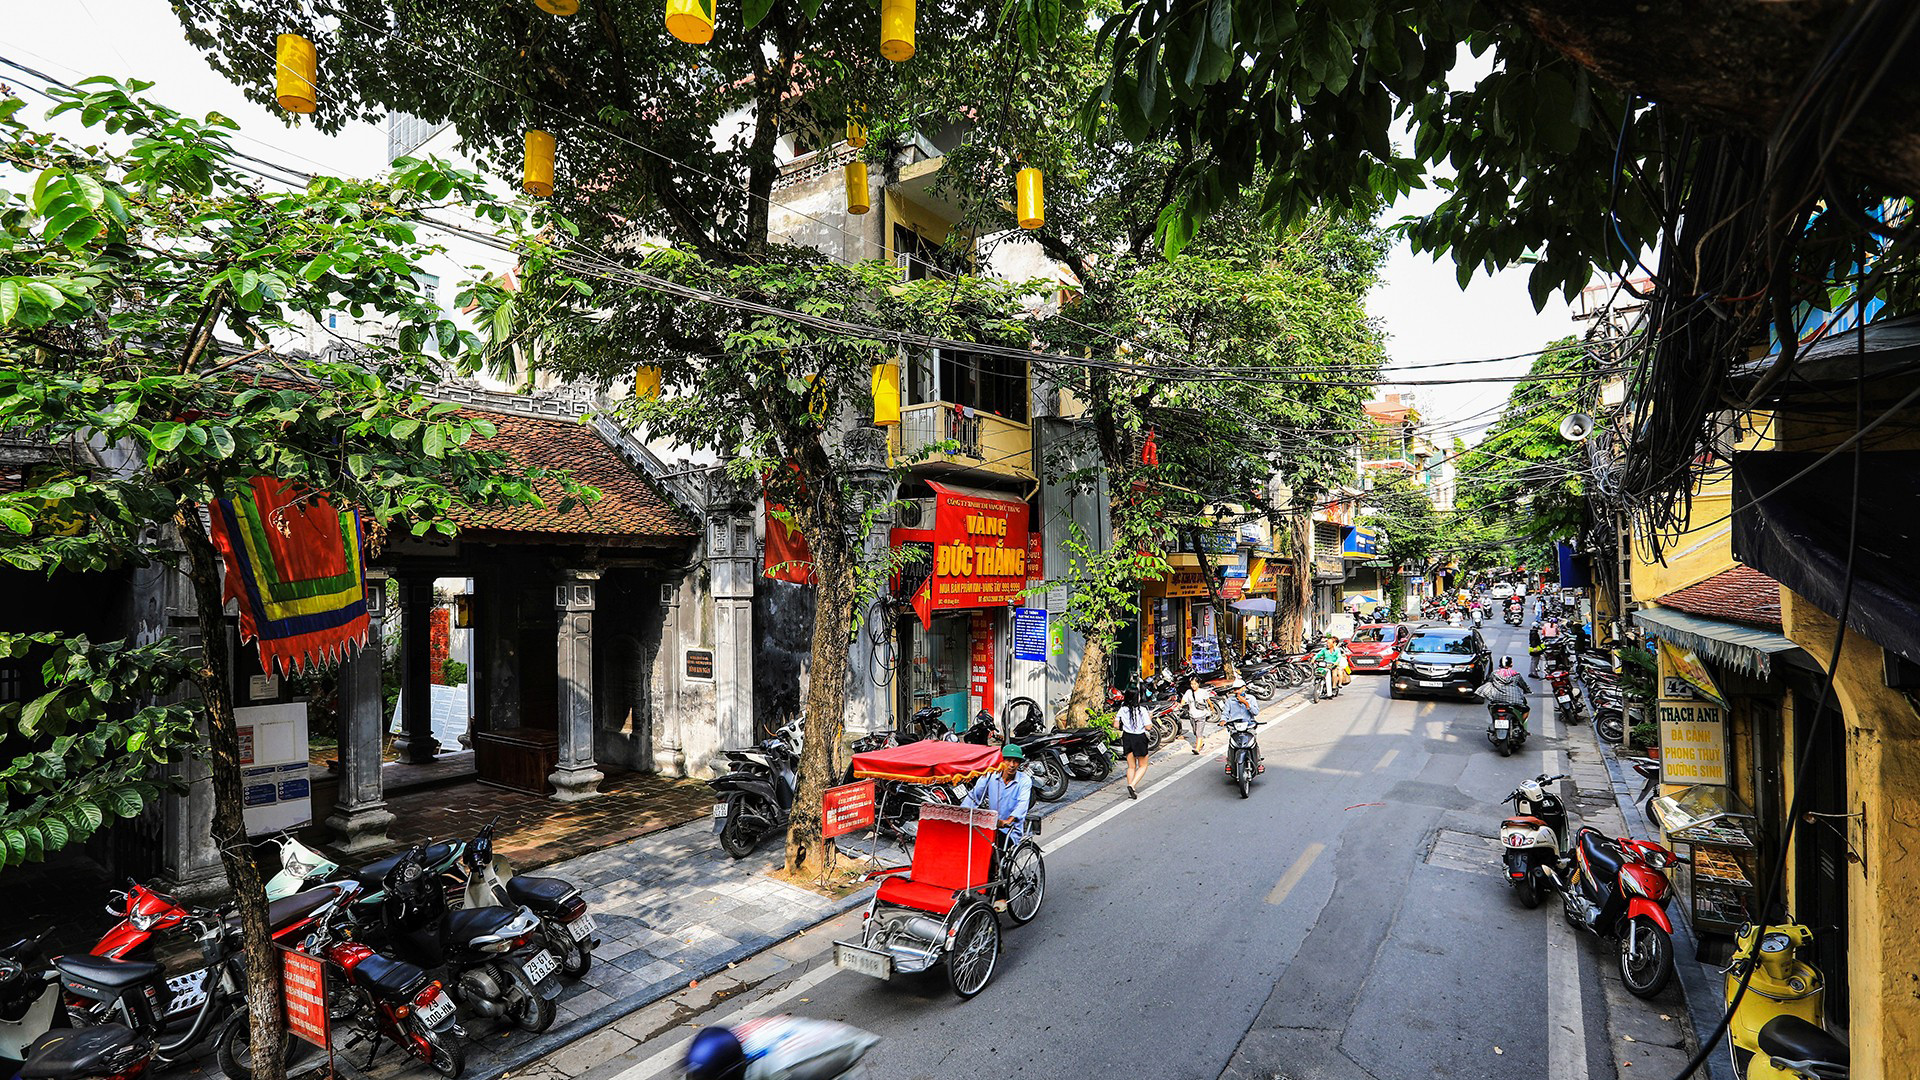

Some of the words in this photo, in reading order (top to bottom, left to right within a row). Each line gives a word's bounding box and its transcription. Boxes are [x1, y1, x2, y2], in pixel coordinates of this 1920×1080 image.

[966, 512, 1007, 537] VÀNG
[937, 539, 973, 577] ĐỨC
[975, 538, 1025, 576] THẮNG
[940, 582, 950, 594] MUA
[951, 581, 961, 593] BÁN
[1660, 707, 1694, 725] THẠCH
[1697, 707, 1719, 722] ANH
[1671, 727, 1683, 741] ĐÁ
[1686, 726, 1711, 742] CẢNH
[1665, 747, 1696, 760] PHONG
[1667, 762, 1698, 777] DƯỠNG
[1700, 765, 1722, 777] SINH
[575, 922, 594, 939] 5591
